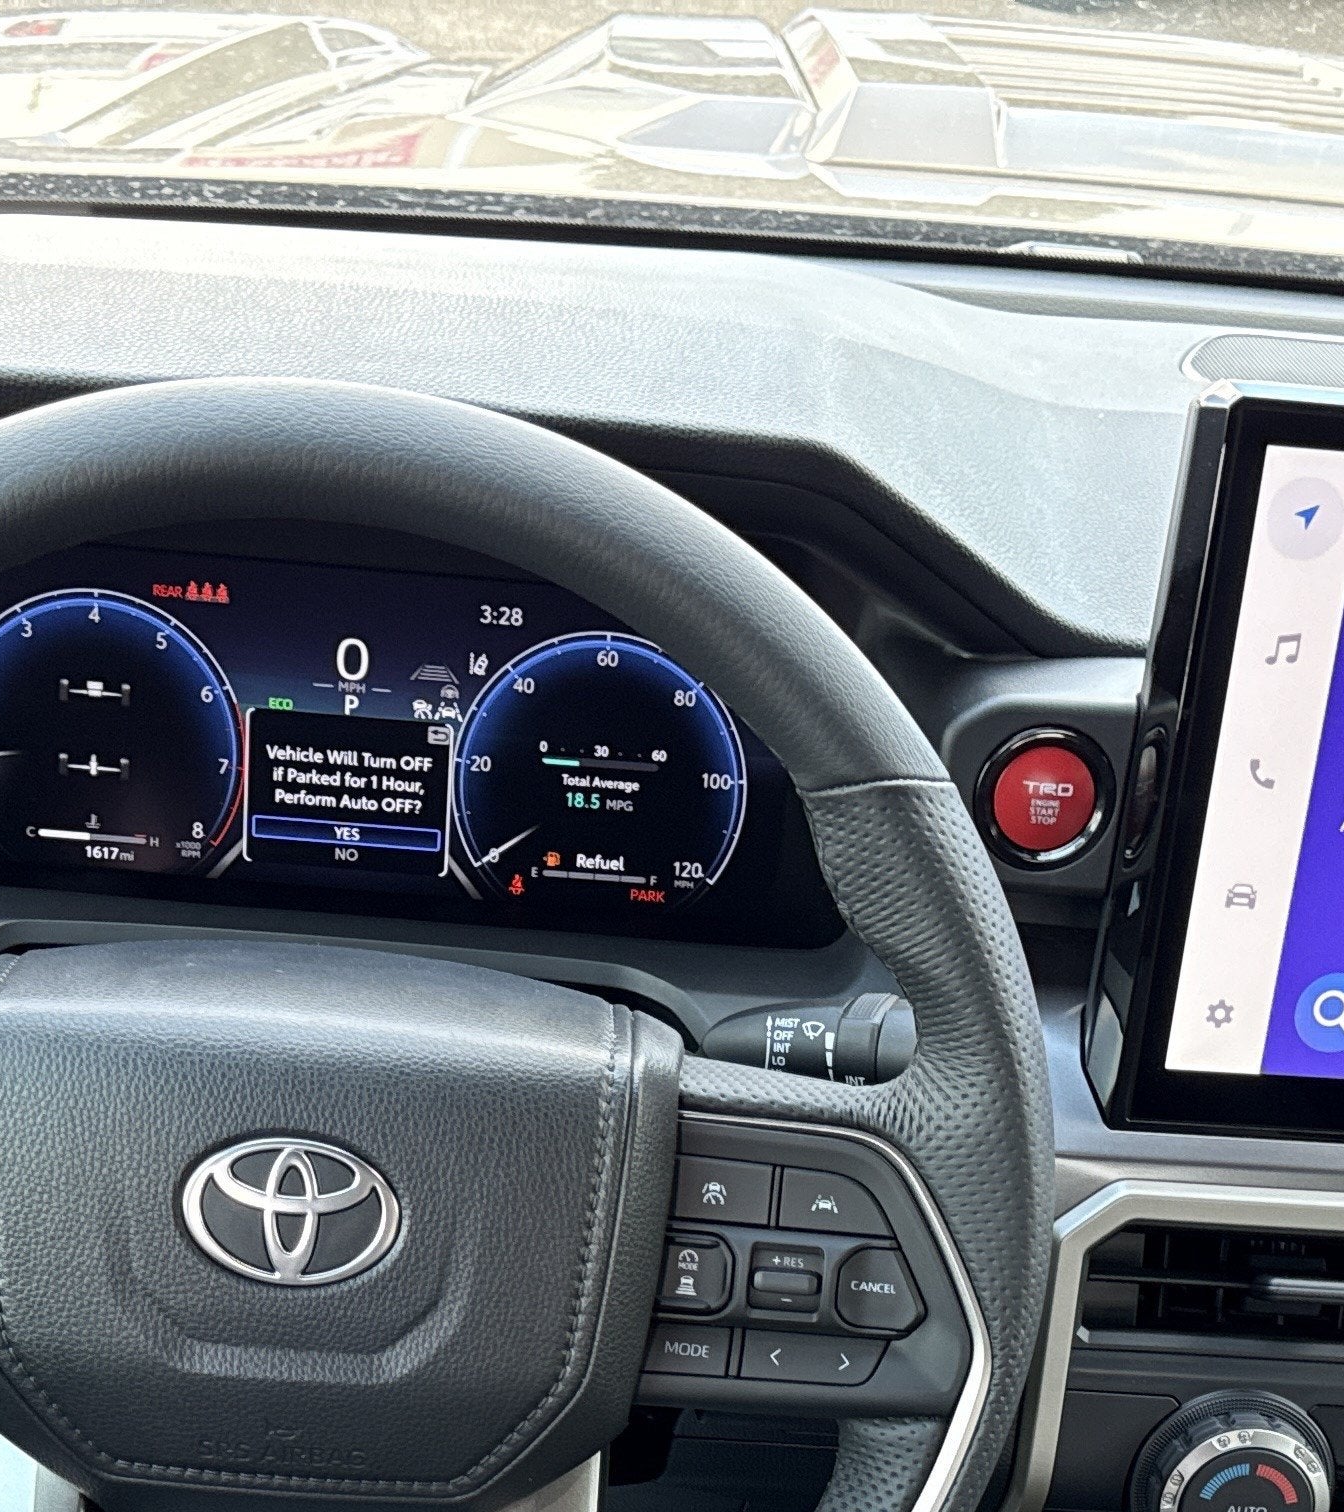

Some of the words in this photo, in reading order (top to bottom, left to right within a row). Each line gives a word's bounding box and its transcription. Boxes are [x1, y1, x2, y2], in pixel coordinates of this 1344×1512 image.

[152, 583, 183, 598] REAR
[88, 607, 100, 624] 4
[479, 605, 523, 626] 3:28
[21, 622, 33, 638] 3
[156, 633, 167, 650] 5
[336, 638, 369, 681] 0
[596, 651, 619, 668] 60
[338, 682, 367, 694] MPH
[513, 678, 535, 695] 40
[201, 687, 213, 703] 6
[674, 690, 697, 708] 80
[268, 697, 294, 711] ECO
[343, 695, 360, 716] P
[265, 744, 324, 763] Vehicle
[327, 748, 359, 767] Will
[362, 751, 396, 770] Turn
[399, 755, 433, 773] OFF
[538, 741, 549, 754] 0
[592, 745, 610, 758] 30
[650, 748, 668, 762] 60
[218, 758, 229, 774] 7
[469, 755, 492, 773] 20
[272, 767, 284, 783] if
[286, 768, 341, 788] Parked
[343, 772, 368, 789] for
[382, 774, 425, 795] Hour,
[562, 773, 590, 789] Total
[591, 776, 640, 795] Average
[701, 773, 730, 790] 100
[1023, 779, 1074, 797] TRD
[274, 789, 338, 809] Perform
[341, 793, 378, 811] Auto
[382, 797, 422, 815] OFF?
[565, 791, 601, 810] 18.5
[606, 797, 634, 812] MPG
[1030, 807, 1060, 816] START
[1030, 816, 1057, 825] STOP
[26, 826, 36, 837] C
[192, 822, 204, 838] 8
[334, 826, 361, 841] YES
[334, 847, 359, 862] NO
[575, 854, 625, 872] Refuel
[673, 861, 703, 878] 120
[649, 875, 658, 887] F
[629, 888, 665, 903] PARK
[774, 1018, 801, 1028] MIST
[773, 1030, 794, 1041] OFF
[773, 1042, 791, 1053] INT
[772, 1055, 786, 1066] LO
[845, 1075, 866, 1086] INT
[678, 1261, 699, 1271] MODE
[850, 1281, 896, 1295] CANCEL
[664, 1341, 710, 1358] MODE
